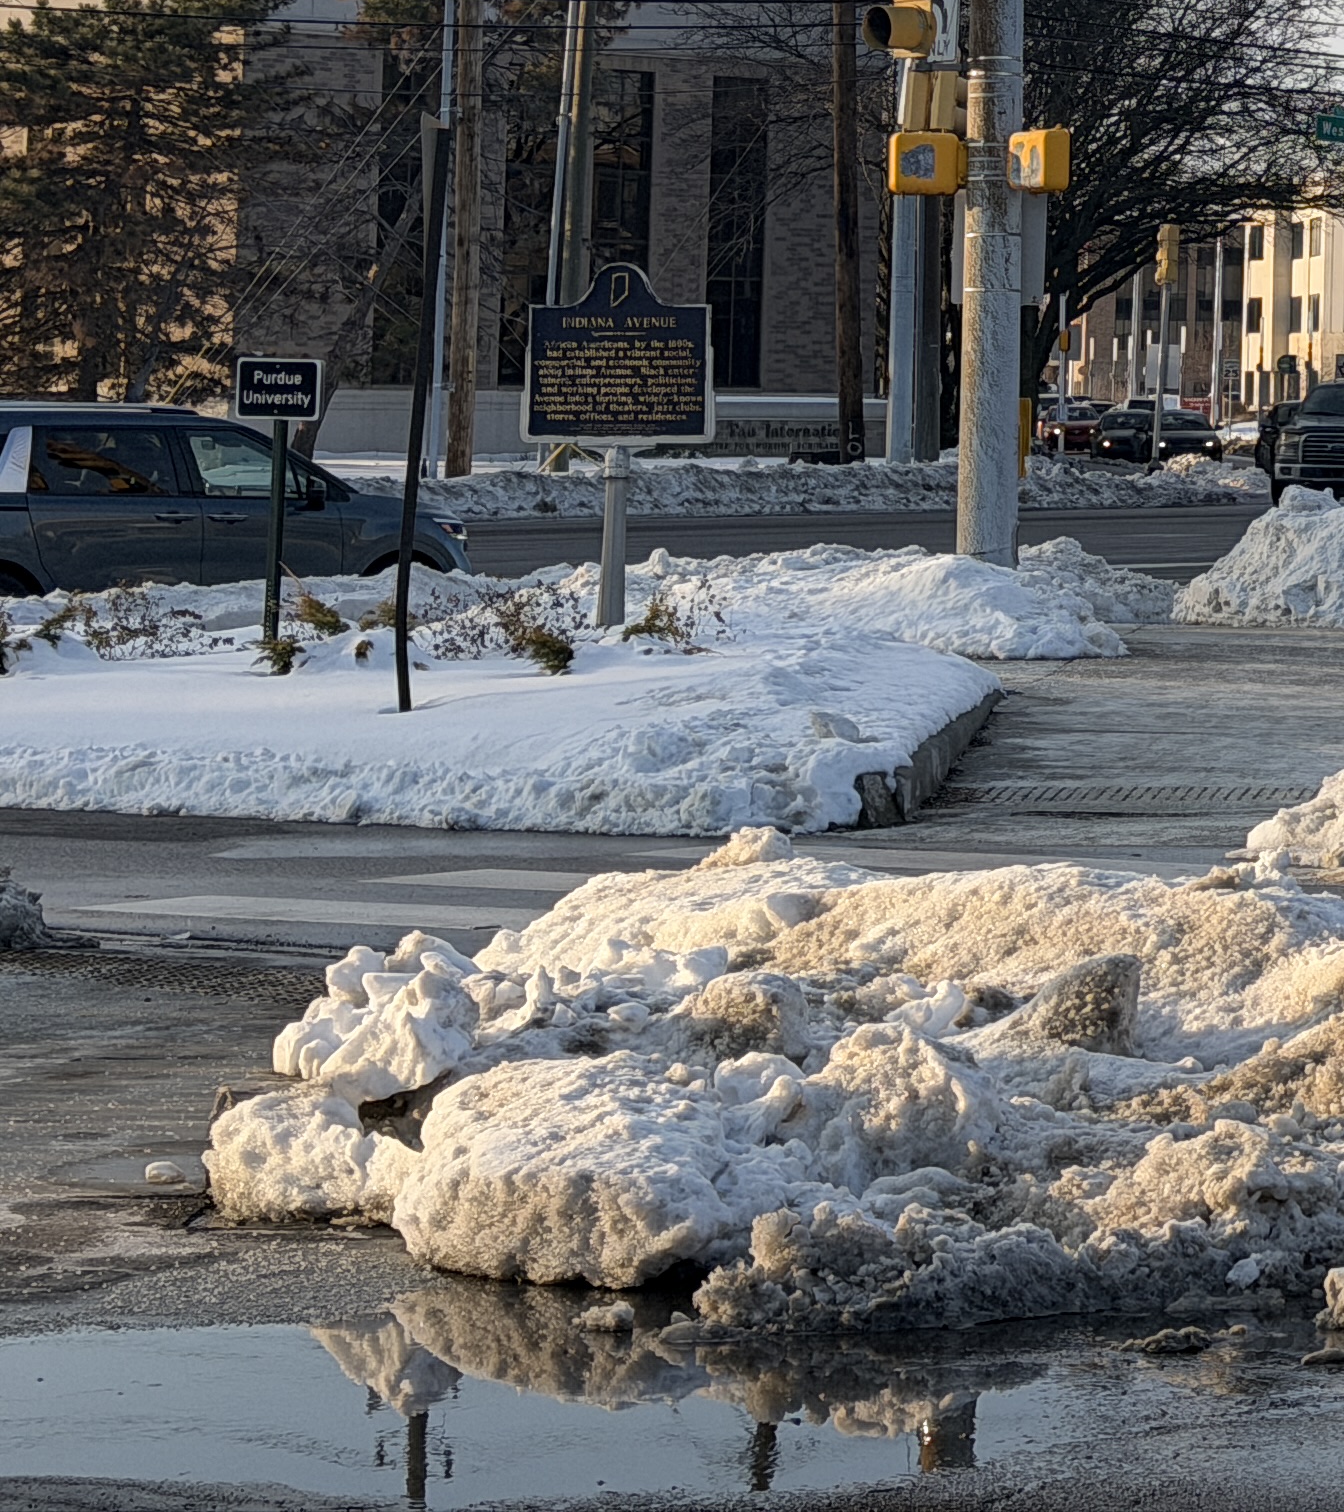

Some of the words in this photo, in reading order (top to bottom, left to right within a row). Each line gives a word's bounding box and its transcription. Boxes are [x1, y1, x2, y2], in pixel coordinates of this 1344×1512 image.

[562, 317, 614, 329] INDIANA
[624, 317, 677, 329] AVENUE
[634, 339, 648, 350] by
[651, 339, 665, 349] the
[547, 348, 562, 358] had
[627, 348, 660, 358] vibrant
[590, 358, 607, 367] and
[641, 367, 664, 376] Black
[1224, 369, 1239, 378] 25
[253, 370, 303, 385] Purdue
[541, 385, 558, 394] and
[561, 385, 597, 395] working
[601, 385, 630, 395] people
[632, 385, 678, 395] developed
[681, 385, 696, 393] the
[243, 389, 312, 409] University
[596, 403, 608, 412] of
[652, 403, 673, 413] jazz
[617, 413, 635, 422] and
